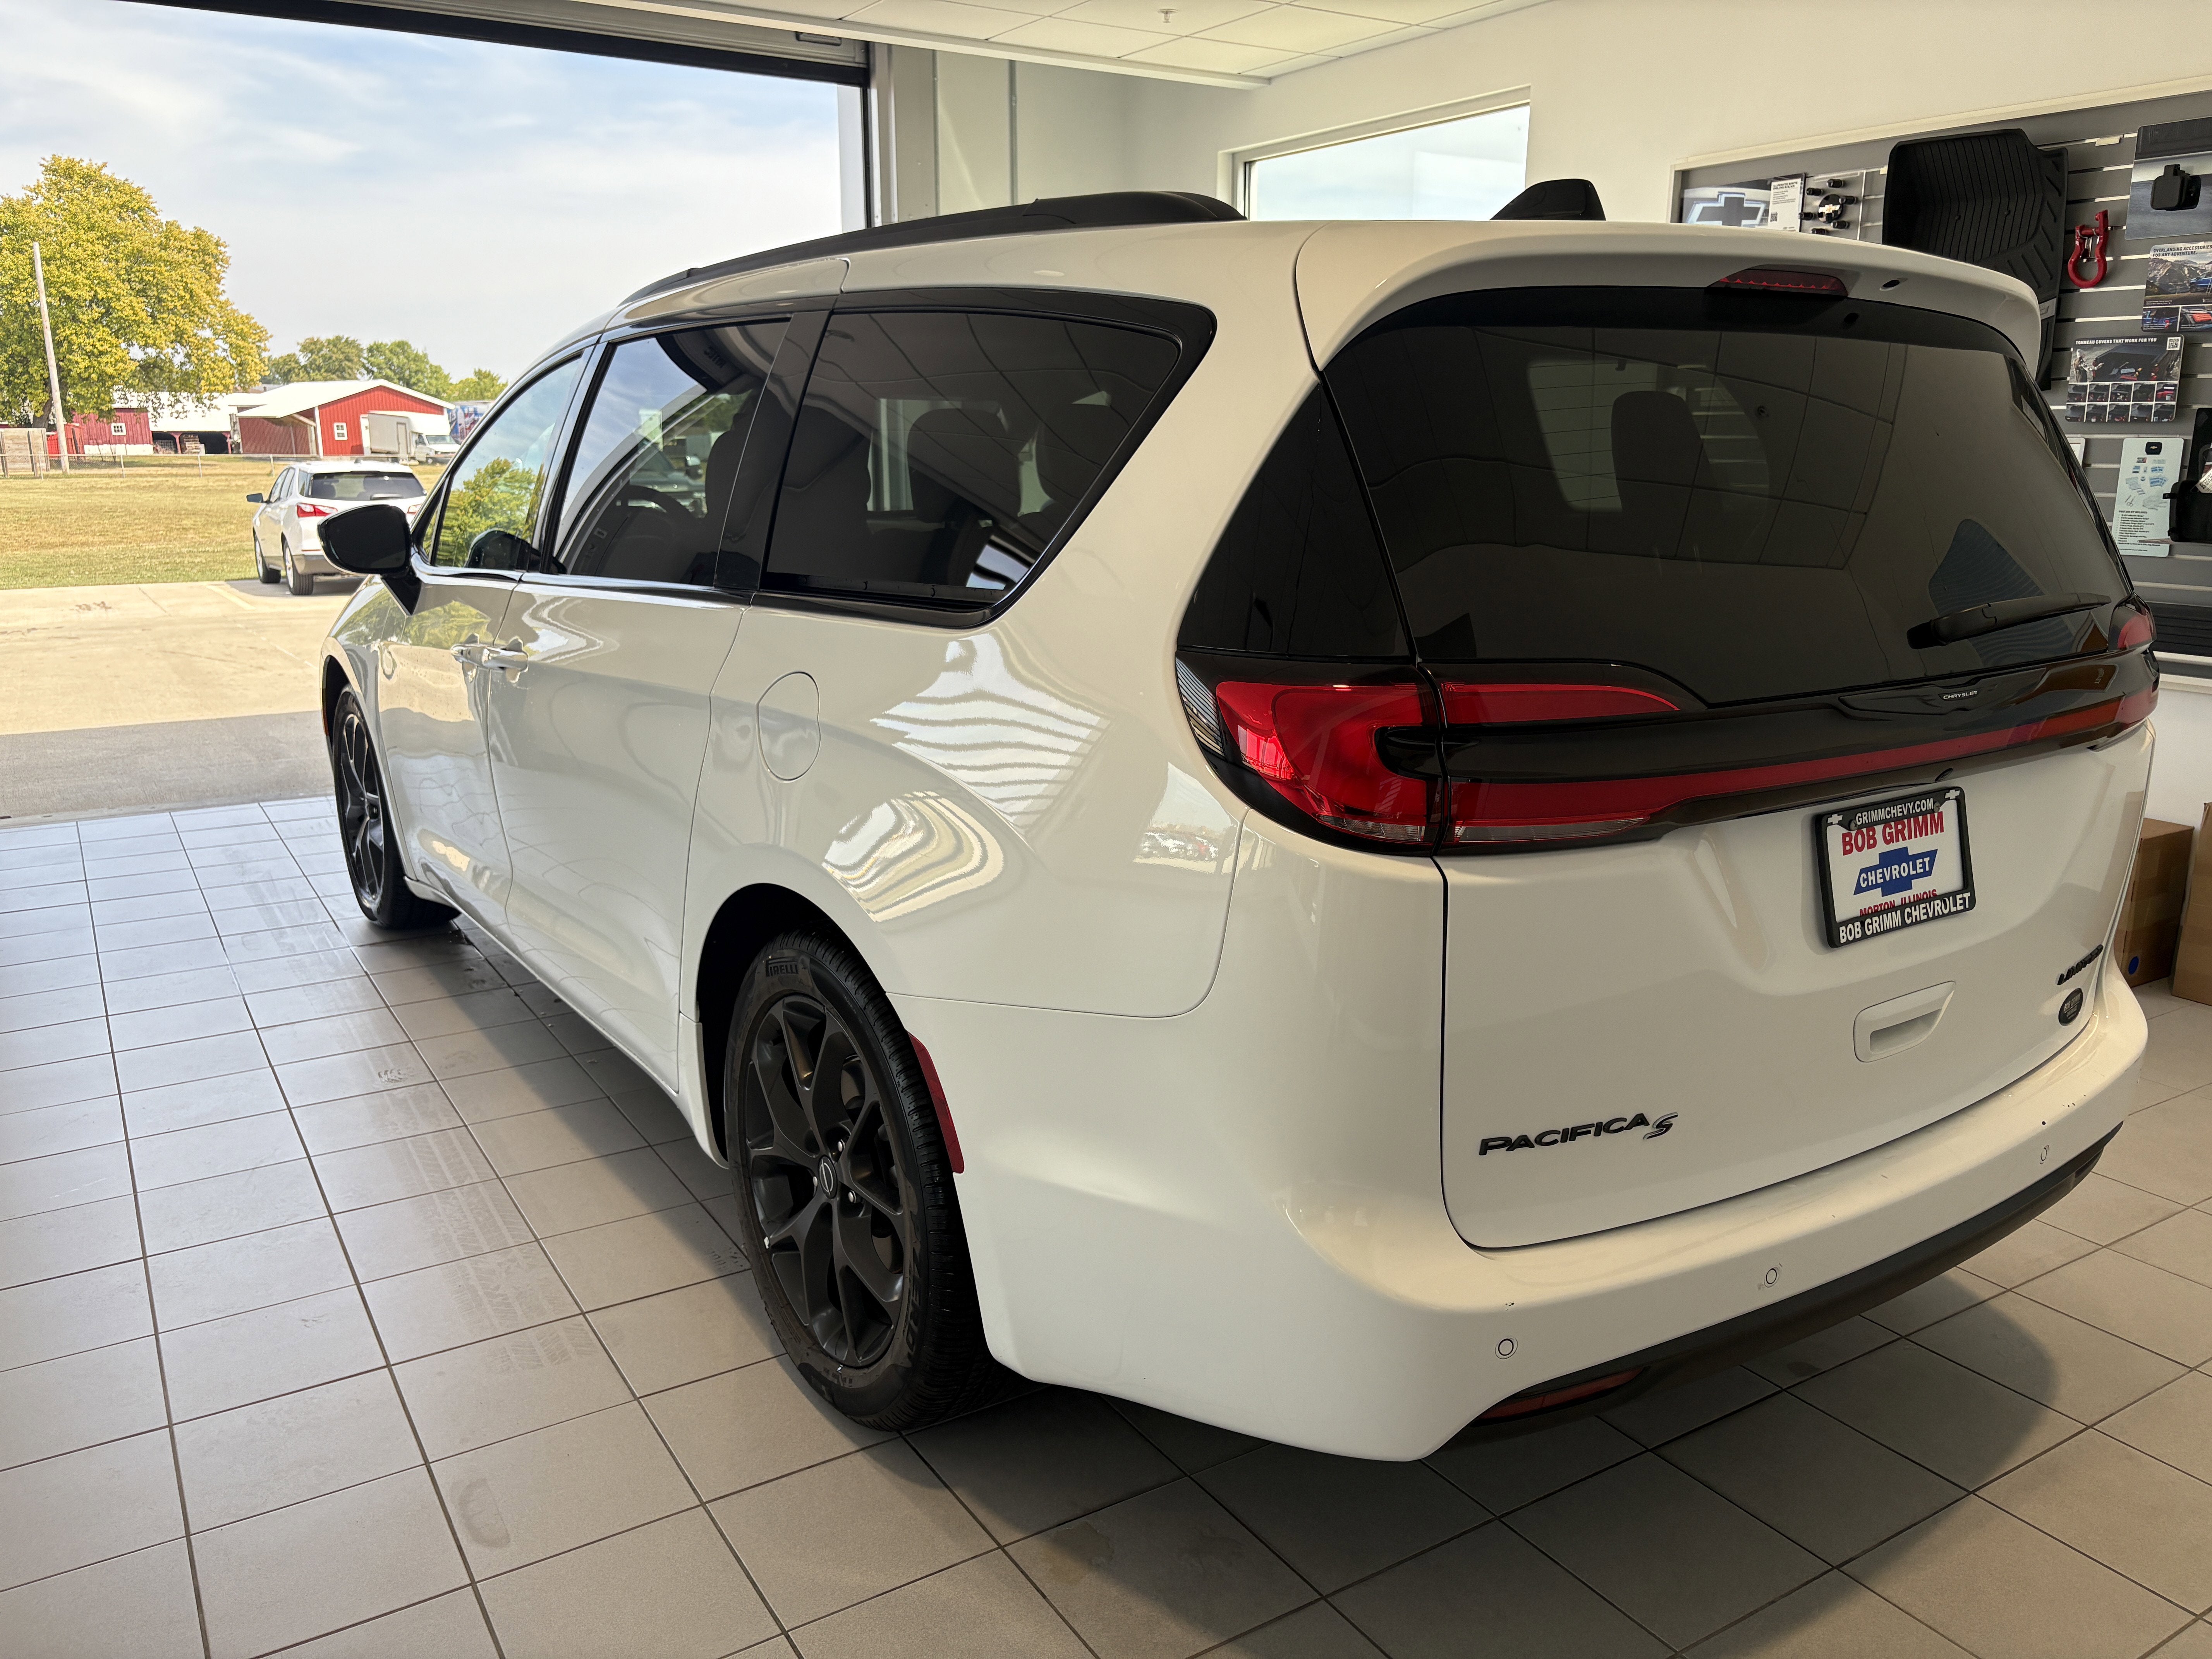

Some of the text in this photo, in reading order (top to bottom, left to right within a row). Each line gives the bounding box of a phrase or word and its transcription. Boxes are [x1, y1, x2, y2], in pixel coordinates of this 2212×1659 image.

[1943, 690, 1977, 699] CHRYSLER
[1856, 798, 1934, 825] GRIMMCHEVY.COM
[1842, 811, 1944, 856] BOB GRIMM
[1860, 857, 1930, 887] CHEVROLET
[1839, 892, 1971, 943] BOB GRIMM CHEVROLET
[766, 957, 798, 977] PIRELLI
[1479, 1112, 1678, 1156] PACIFICA S
